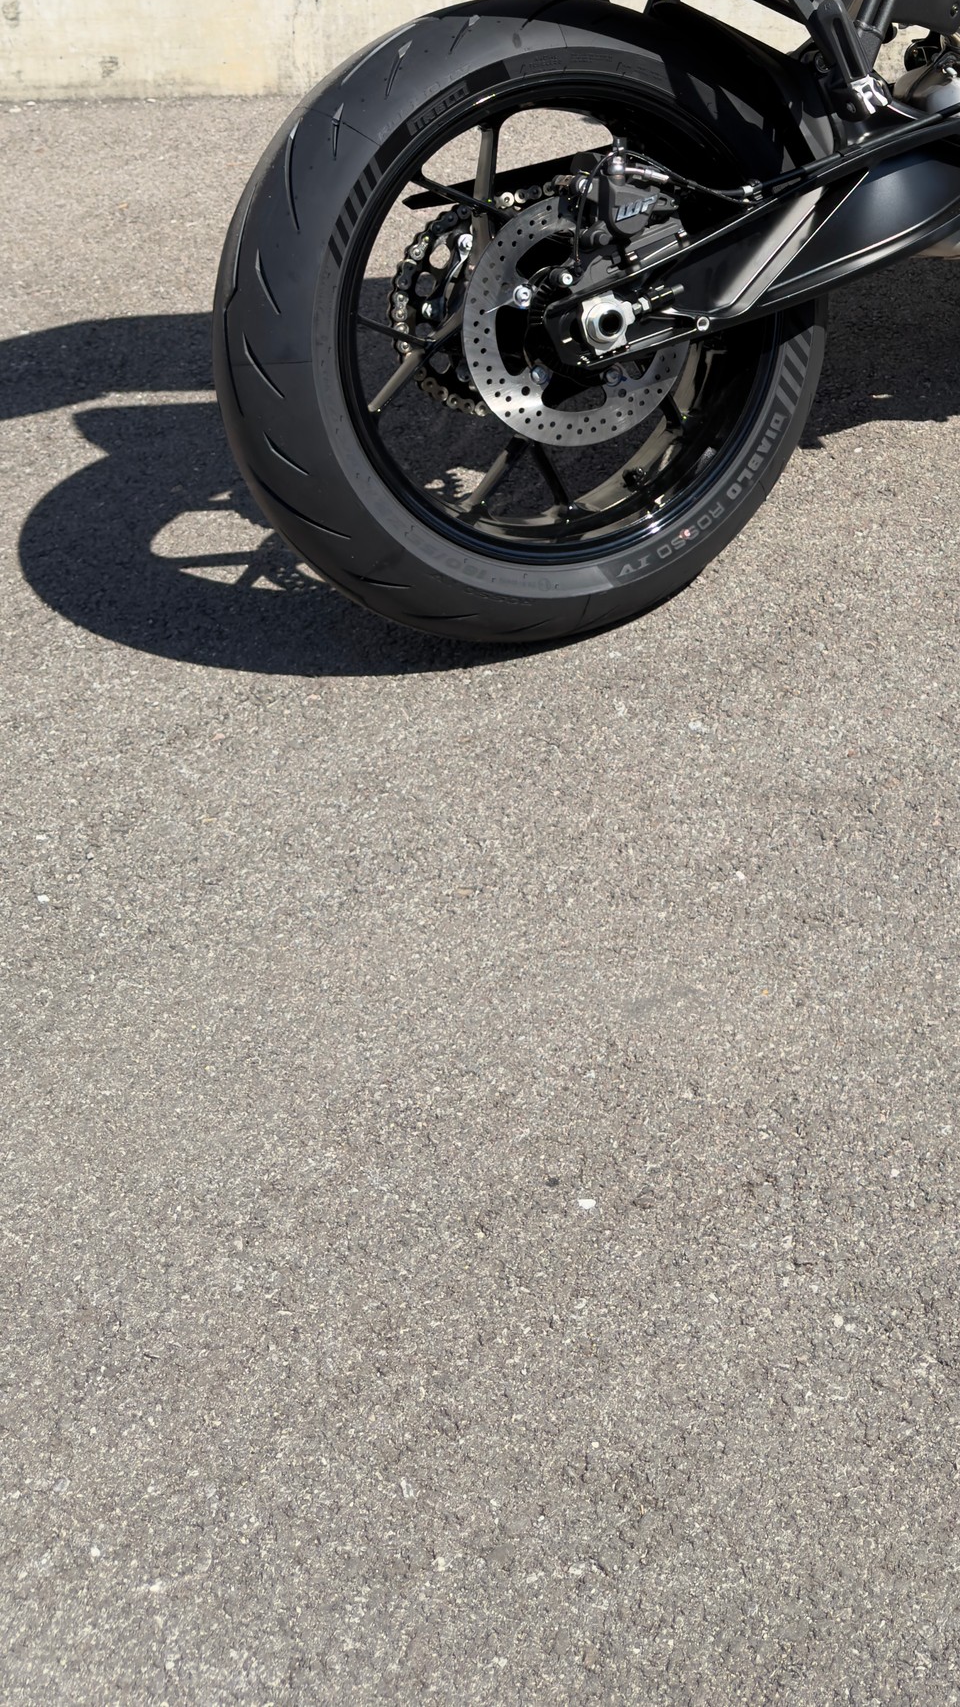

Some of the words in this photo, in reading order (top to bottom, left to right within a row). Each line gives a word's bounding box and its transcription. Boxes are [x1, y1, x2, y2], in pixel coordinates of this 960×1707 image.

[406, 79, 471, 136] PIRELLI
[615, 194, 658, 222] WP
[726, 411, 788, 500] DIABLO
[656, 501, 725, 560] ROSSO
[615, 553, 652, 578] IV
